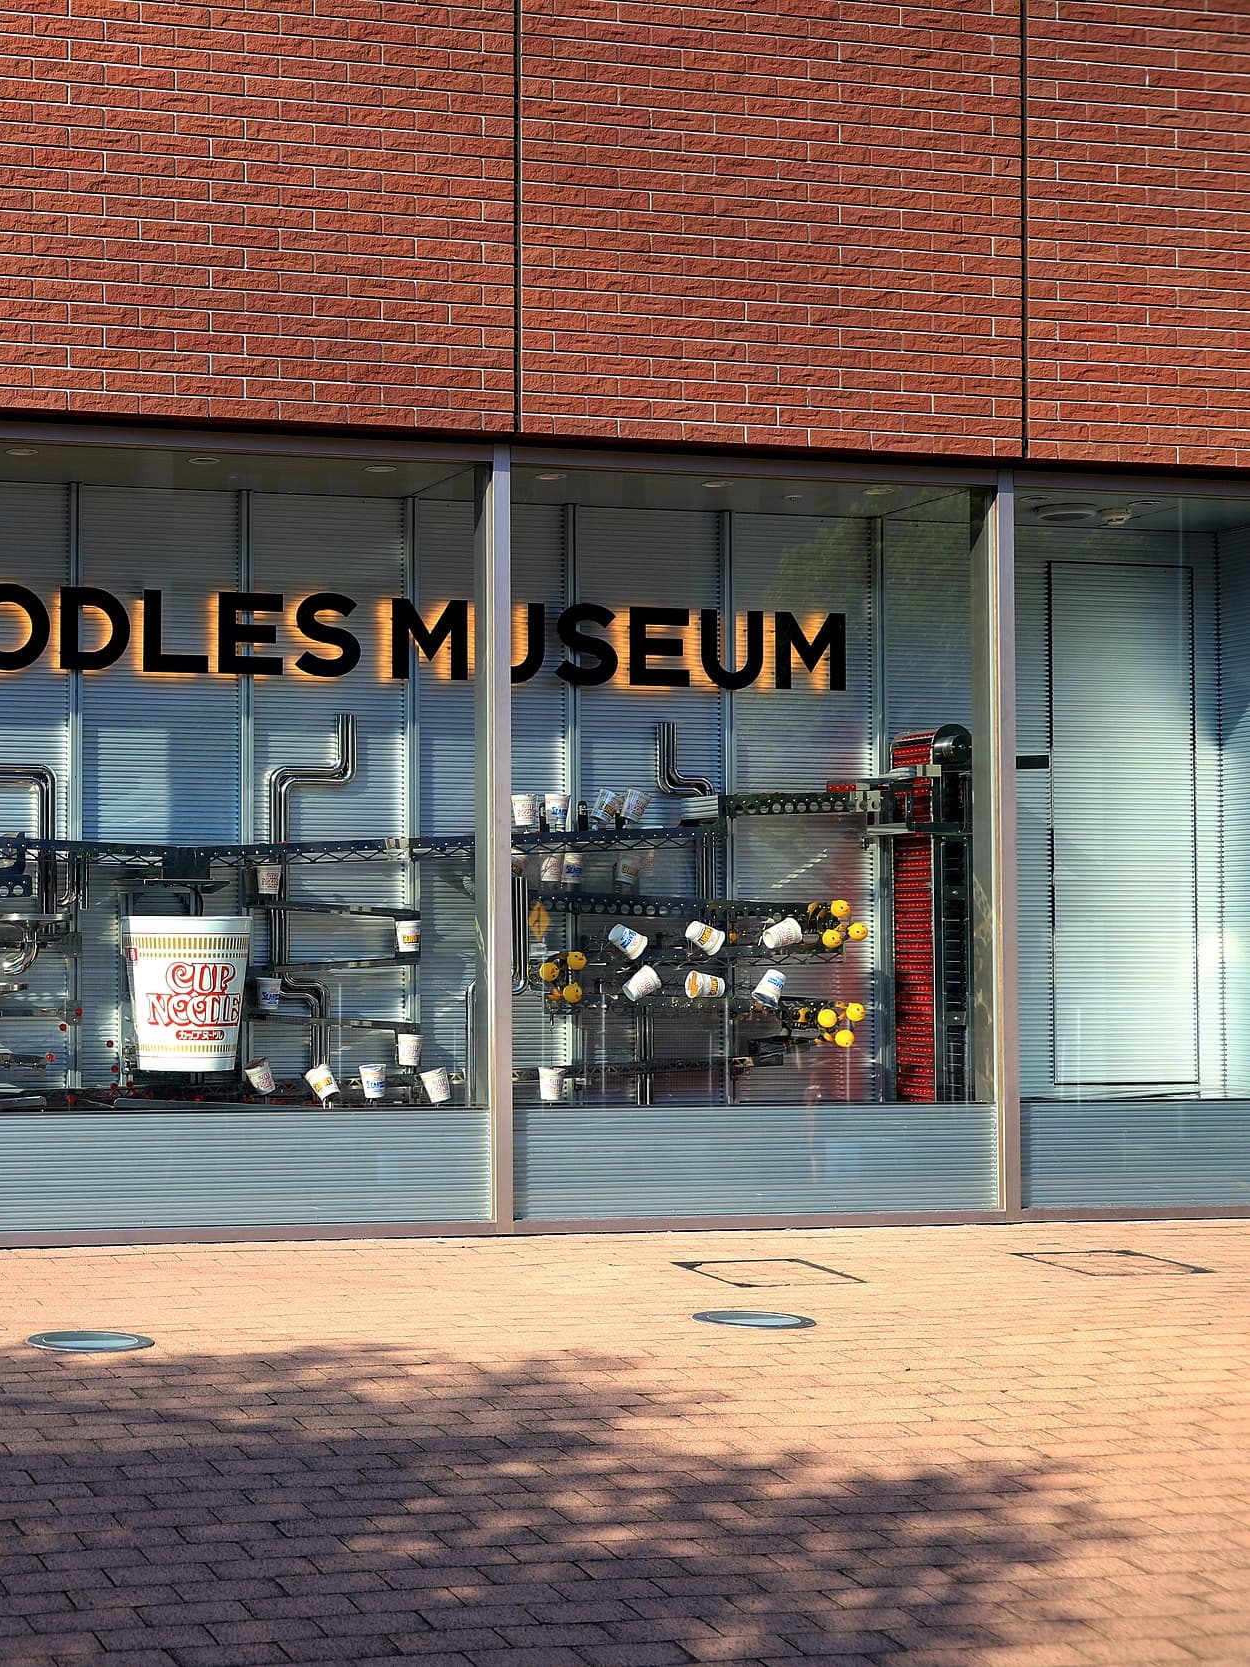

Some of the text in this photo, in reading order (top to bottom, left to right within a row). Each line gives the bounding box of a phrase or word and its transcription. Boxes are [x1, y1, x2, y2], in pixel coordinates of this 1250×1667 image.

[391, 597, 847, 692] MUSEUM
[165, 961, 237, 995] CUP
[146, 993, 241, 1027] NOODLE
